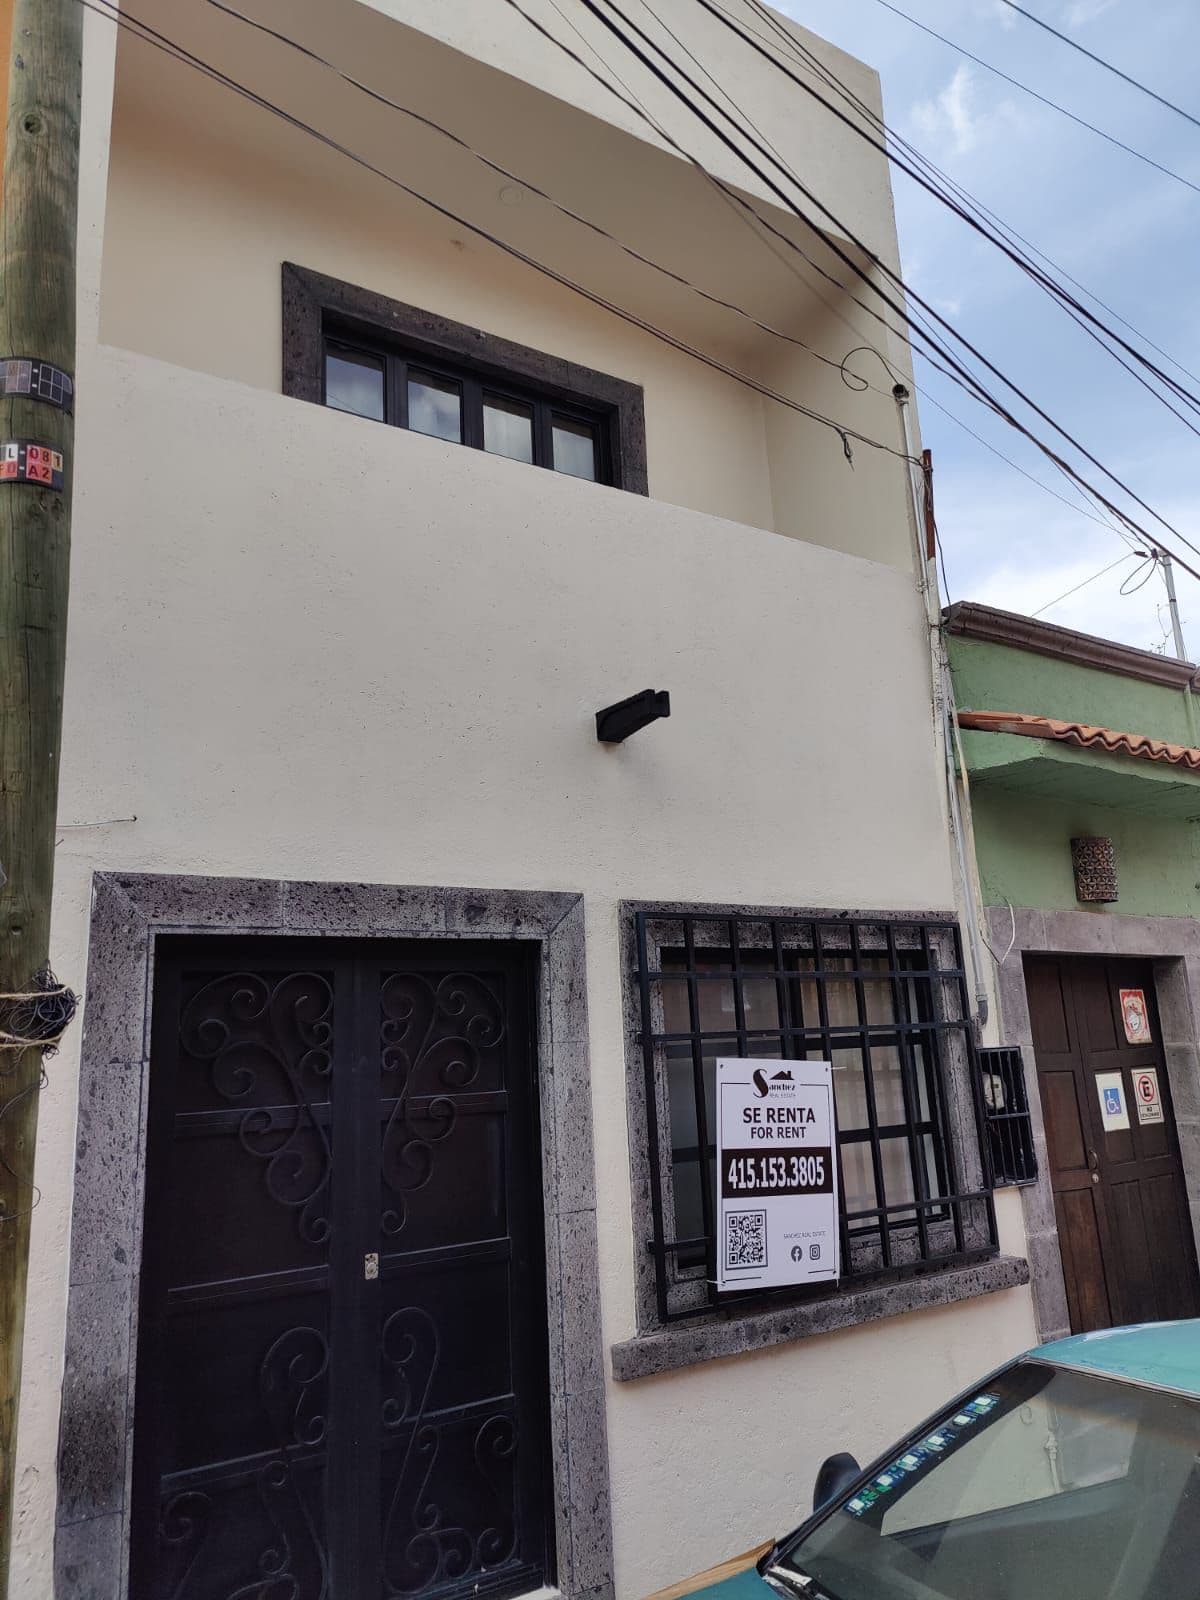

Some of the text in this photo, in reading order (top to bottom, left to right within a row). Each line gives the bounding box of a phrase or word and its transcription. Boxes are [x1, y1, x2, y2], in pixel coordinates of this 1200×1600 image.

[743, 1107, 816, 1123] SE RENTA
[750, 1127, 806, 1139] FOR RENT
[728, 1156, 825, 1189] 415.153.3805
